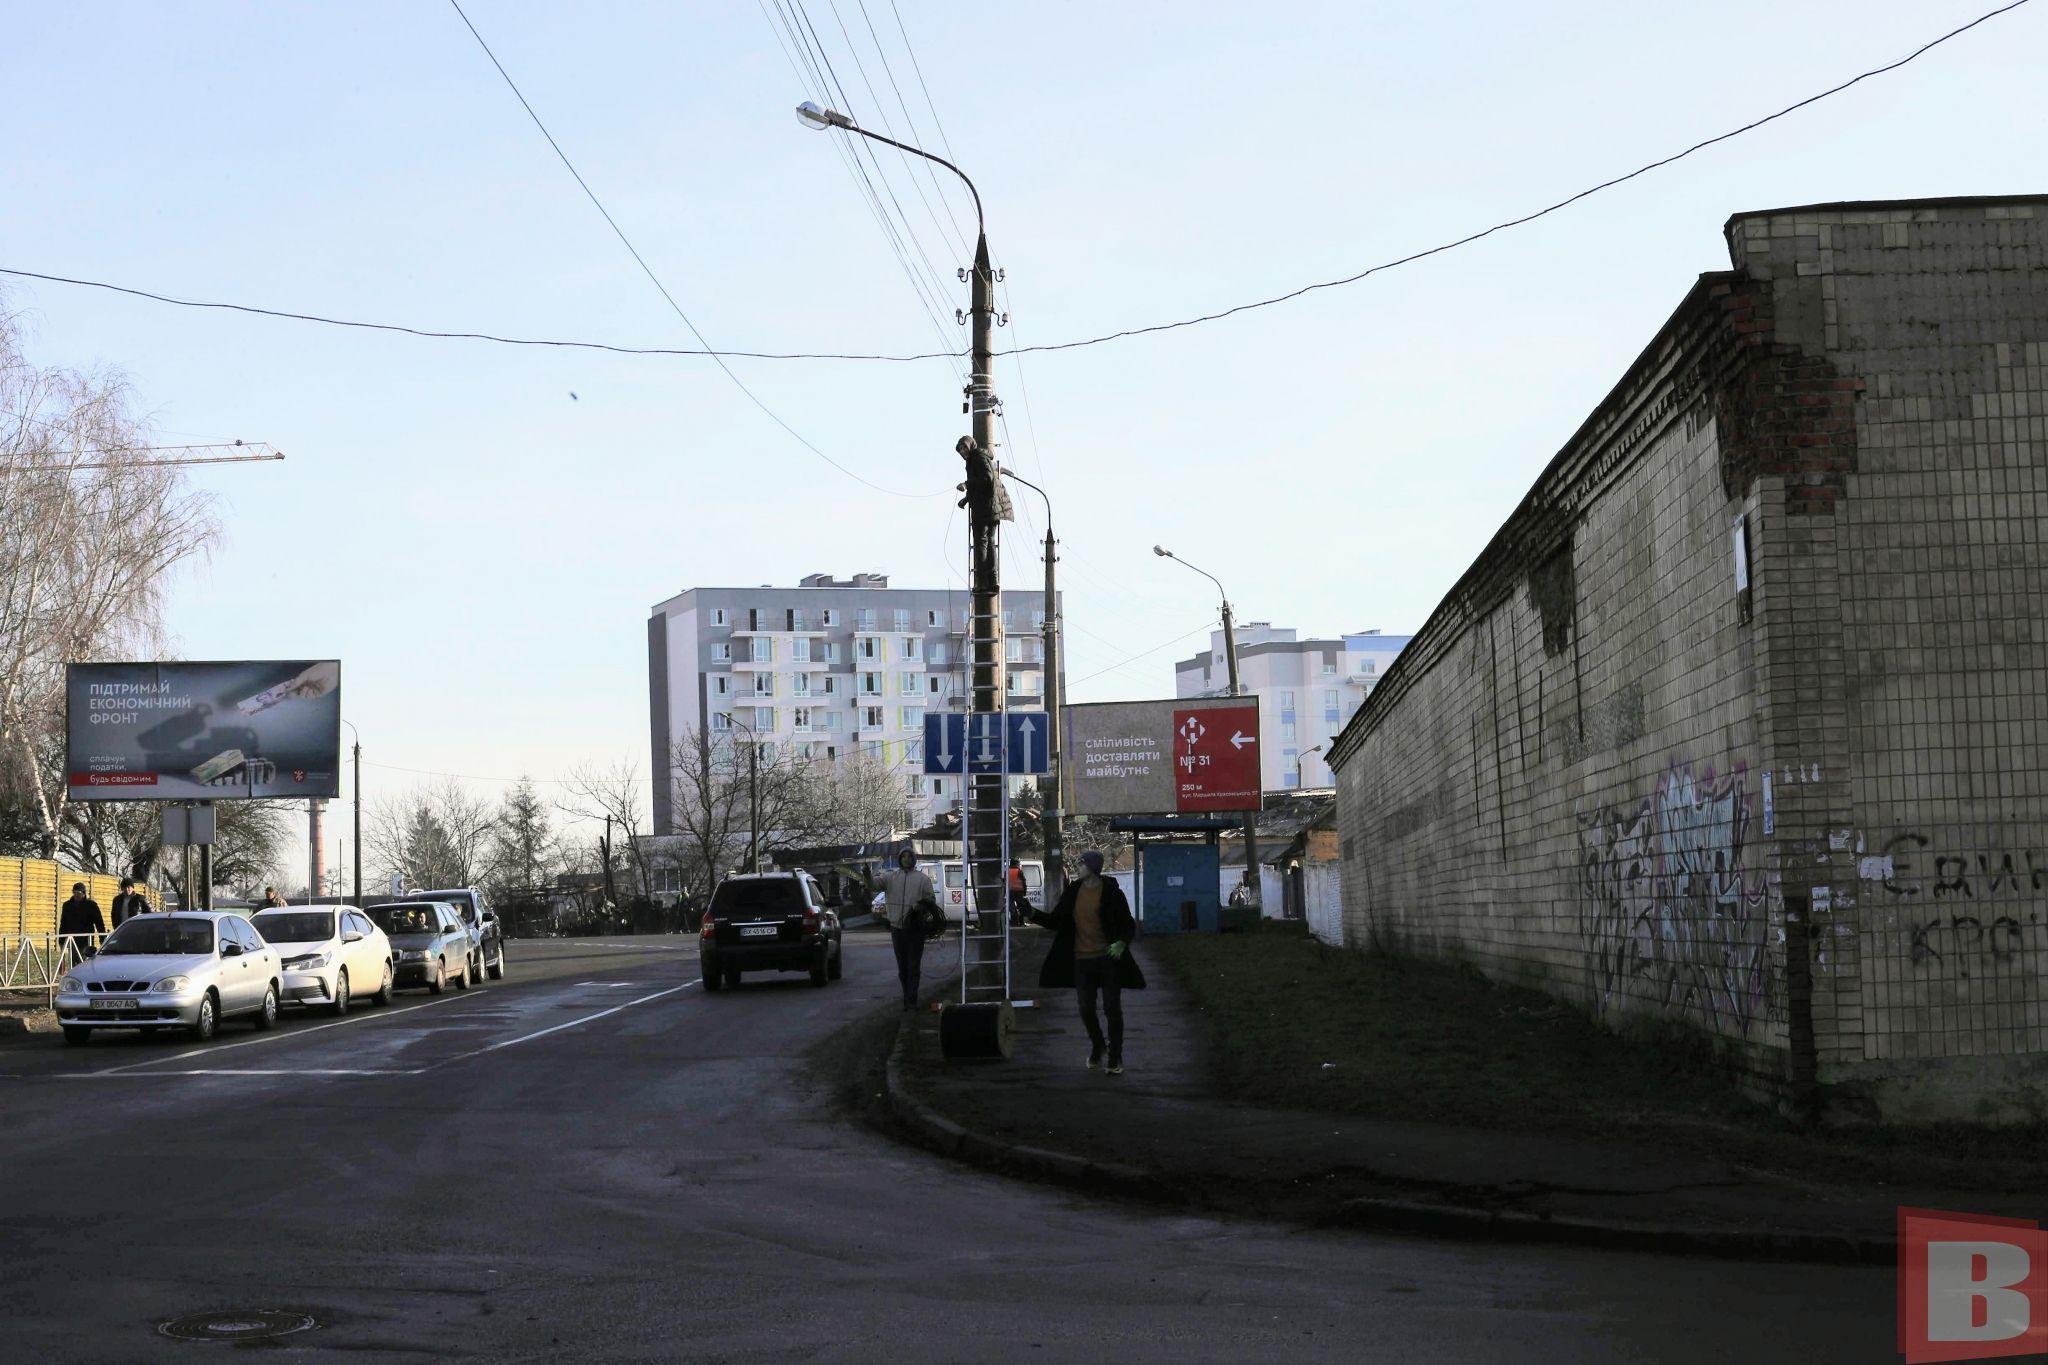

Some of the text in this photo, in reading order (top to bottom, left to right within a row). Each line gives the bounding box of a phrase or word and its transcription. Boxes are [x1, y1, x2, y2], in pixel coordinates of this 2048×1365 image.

[90, 680, 170, 696] ПІДТРИМАЙ
[90, 694, 191, 710] ЕКОНОМІЧНИЙ
[89, 712, 139, 725] ФРОНТ
[1085, 735, 1156, 749] сміливість
[1085, 751, 1160, 764] доставляти
[1198, 755, 1210, 766] 31
[1086, 764, 1151, 778] майбутнє
[90, 774, 110, 785] будь
